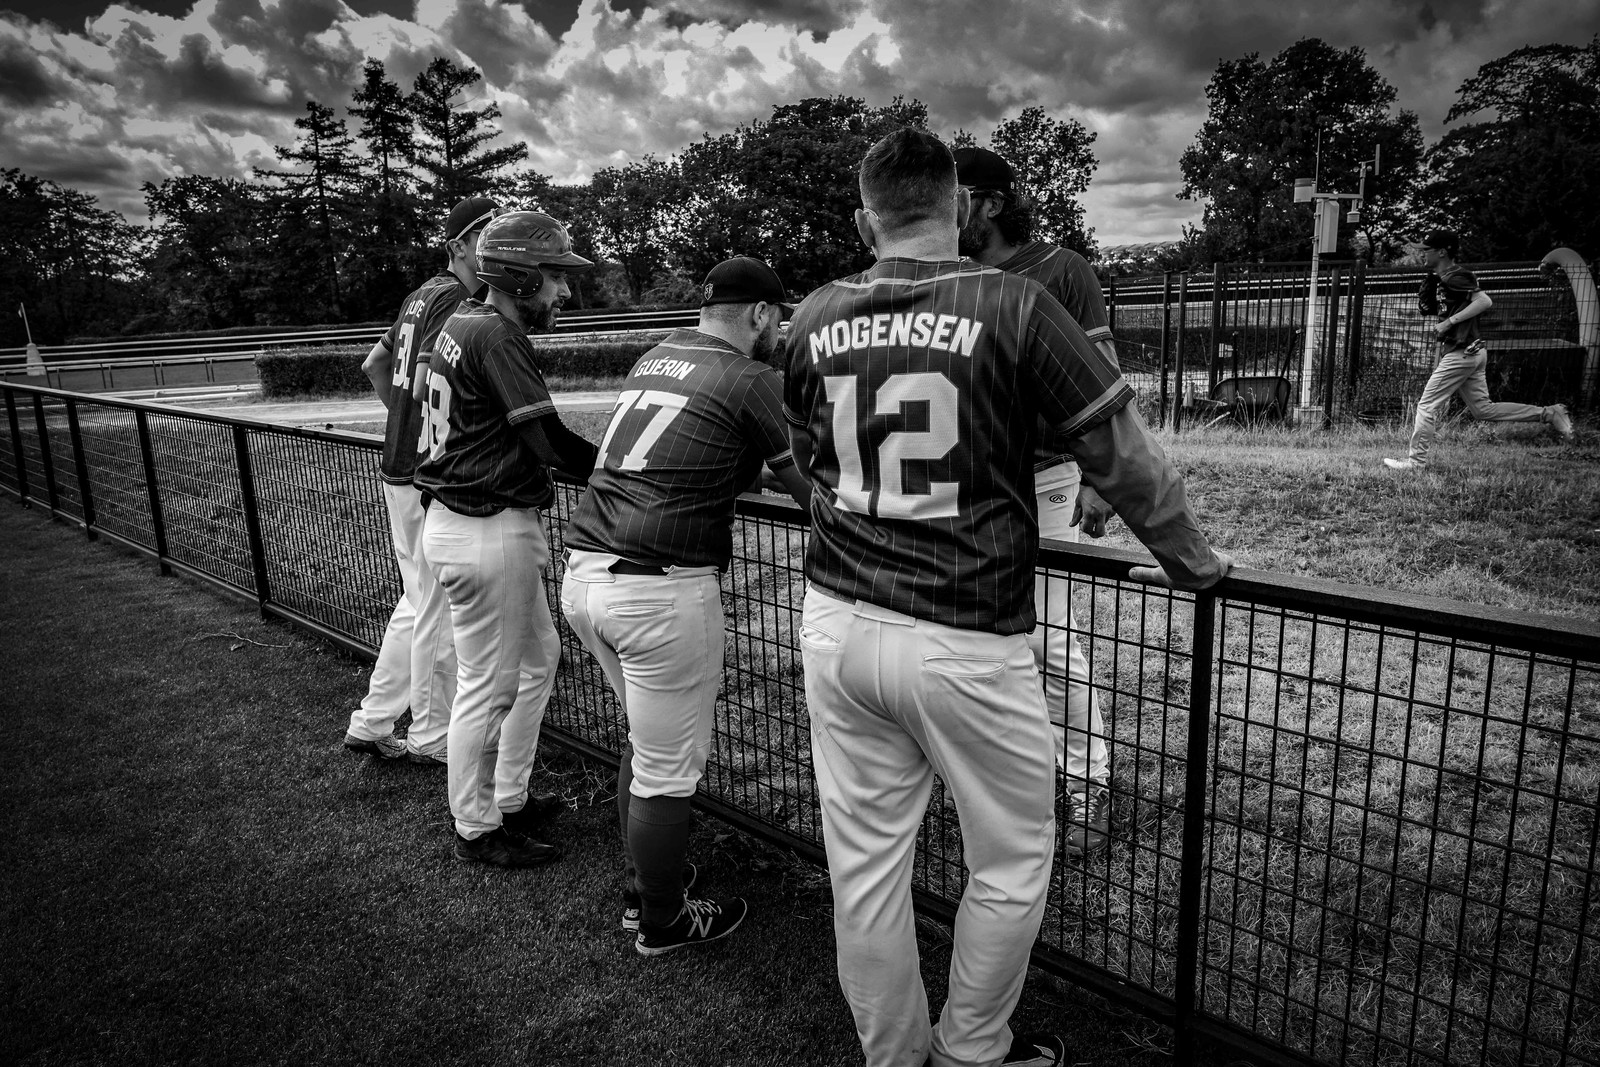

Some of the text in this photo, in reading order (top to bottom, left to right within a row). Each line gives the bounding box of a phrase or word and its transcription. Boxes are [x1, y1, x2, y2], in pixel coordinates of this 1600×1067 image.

[392, 322, 415, 390] 31
[634, 355, 696, 381] GUÉRIN
[808, 311, 983, 365] MOGENSEN
[594, 389, 690, 473] 77
[823, 371, 960, 521] 12
